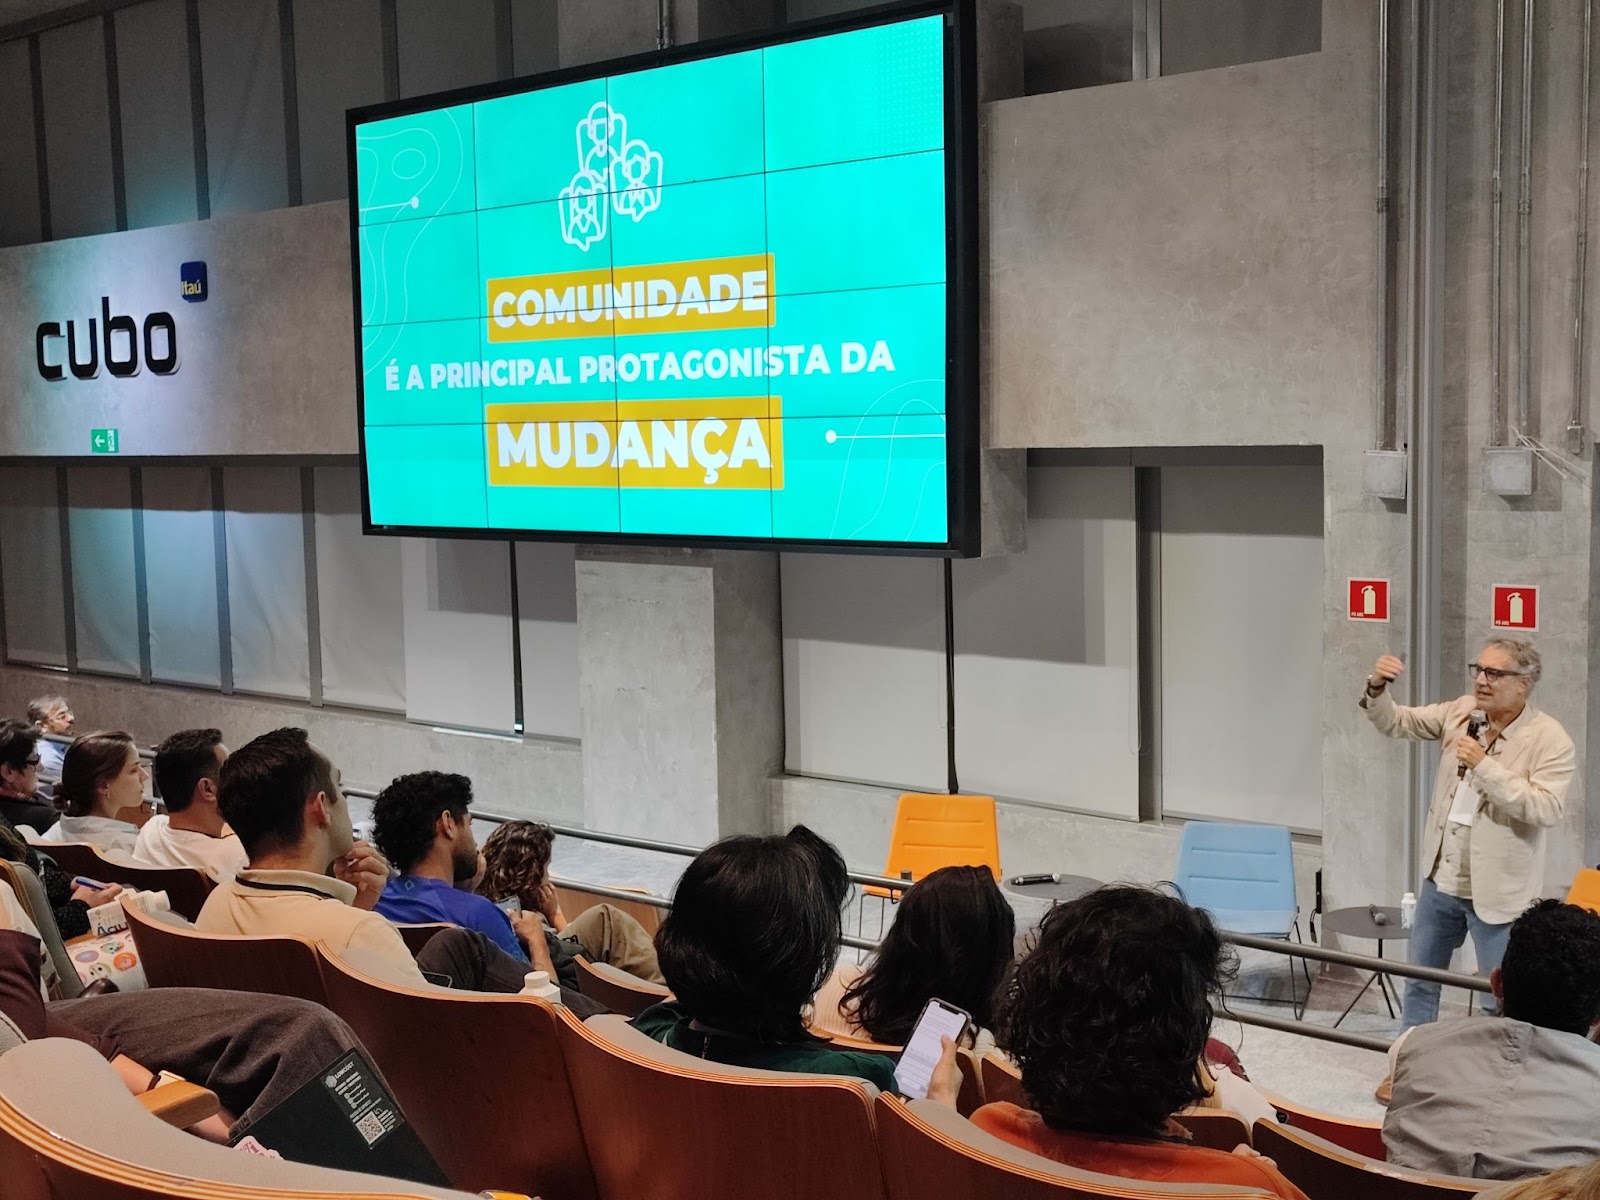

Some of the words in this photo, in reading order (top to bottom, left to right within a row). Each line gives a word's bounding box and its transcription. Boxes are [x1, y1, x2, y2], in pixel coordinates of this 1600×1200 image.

[181, 279, 202, 296] Itaú
[494, 270, 768, 329] COMUNIDADE
[36, 296, 180, 379] cubo
[386, 358, 398, 391] É
[407, 365, 423, 390] A
[431, 357, 571, 390] PRINCIPAL
[579, 344, 832, 384] PROTAGONISTA
[841, 341, 895, 373] DA
[496, 418, 771, 486] MUDANÇA
